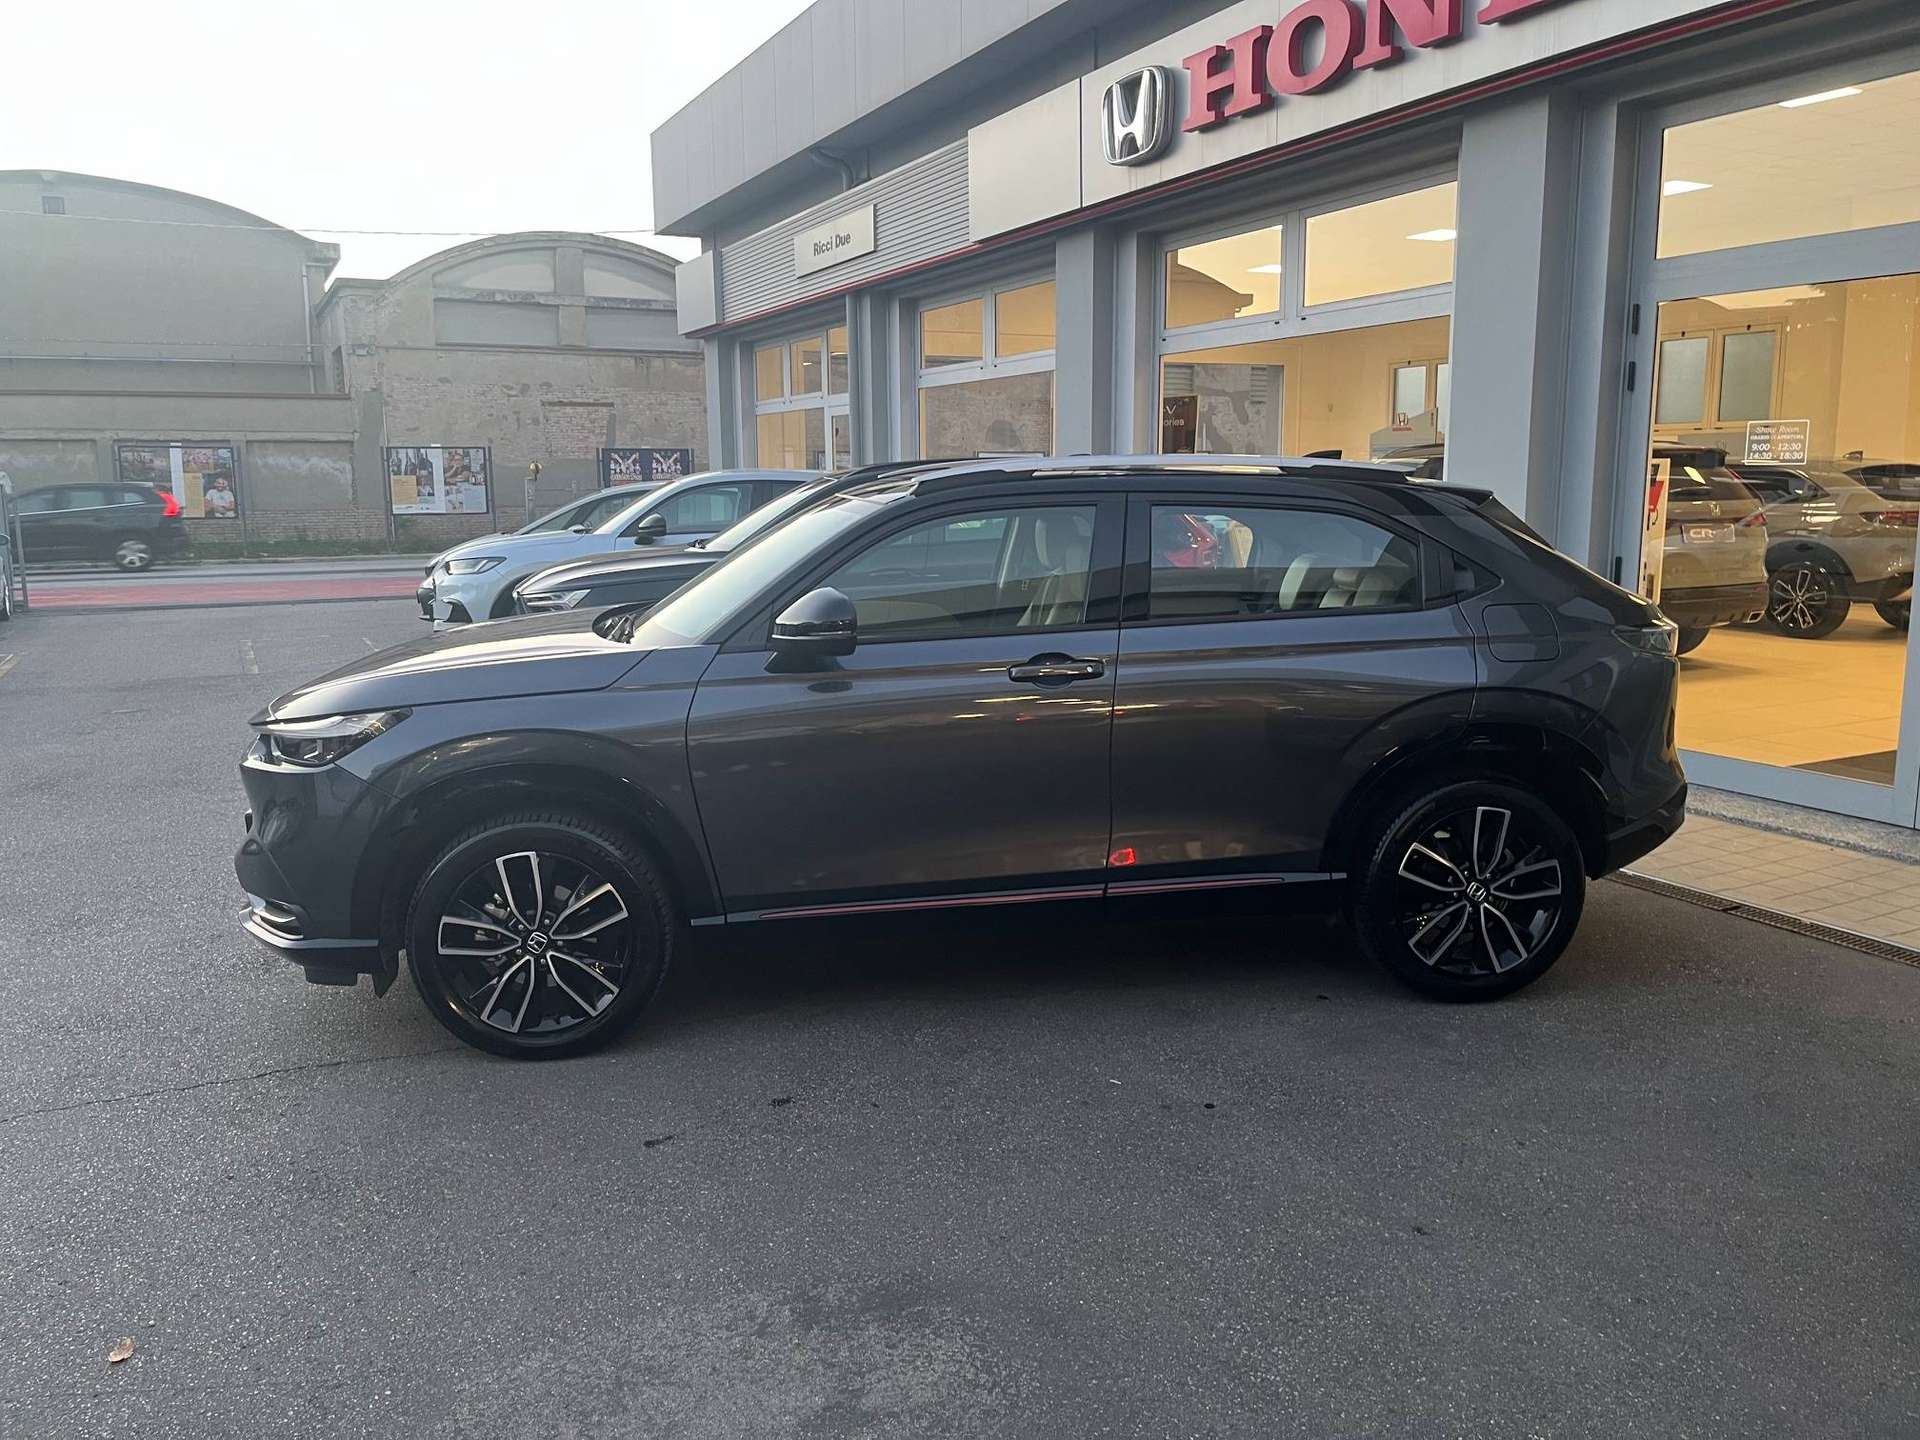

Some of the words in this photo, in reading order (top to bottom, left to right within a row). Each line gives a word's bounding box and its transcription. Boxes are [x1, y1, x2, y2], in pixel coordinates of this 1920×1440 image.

[1182, 0, 1578, 131] HON
[813, 236, 833, 256] Ricci
[835, 233, 851, 248] Due
[1751, 443, 1771, 451] 9:00
[1778, 442, 1801, 450] 12:30
[1748, 452, 1772, 460] 14:30
[1780, 451, 1804, 460] 18:30
